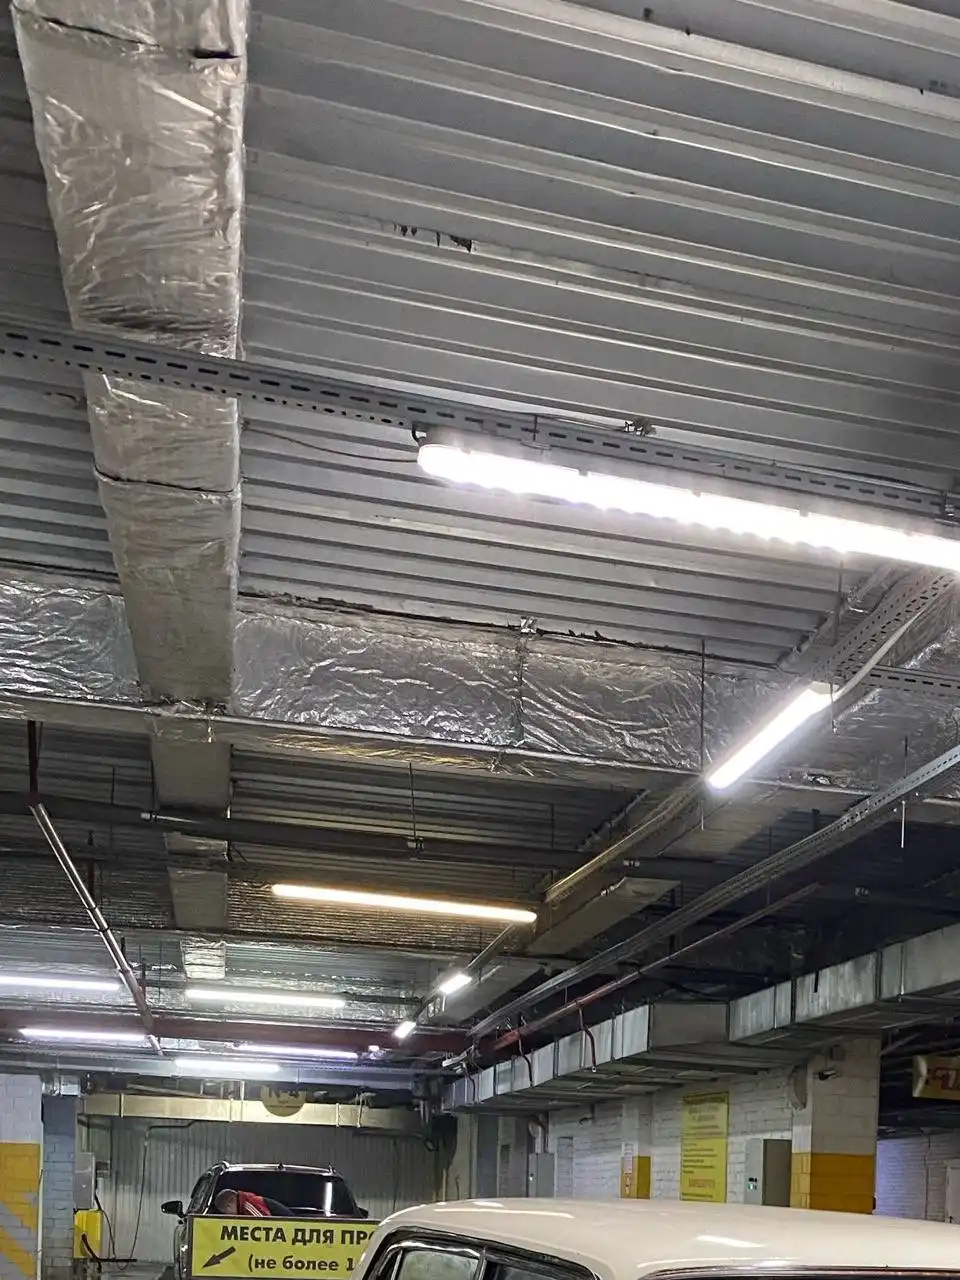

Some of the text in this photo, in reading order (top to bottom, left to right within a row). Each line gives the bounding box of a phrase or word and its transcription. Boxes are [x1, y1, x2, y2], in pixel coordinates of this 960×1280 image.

[220, 1225, 286, 1243] МЕСТА
[292, 1229, 333, 1246] ДЛЯ
[248, 1254, 277, 1273] (не
[282, 1255, 339, 1271] более
